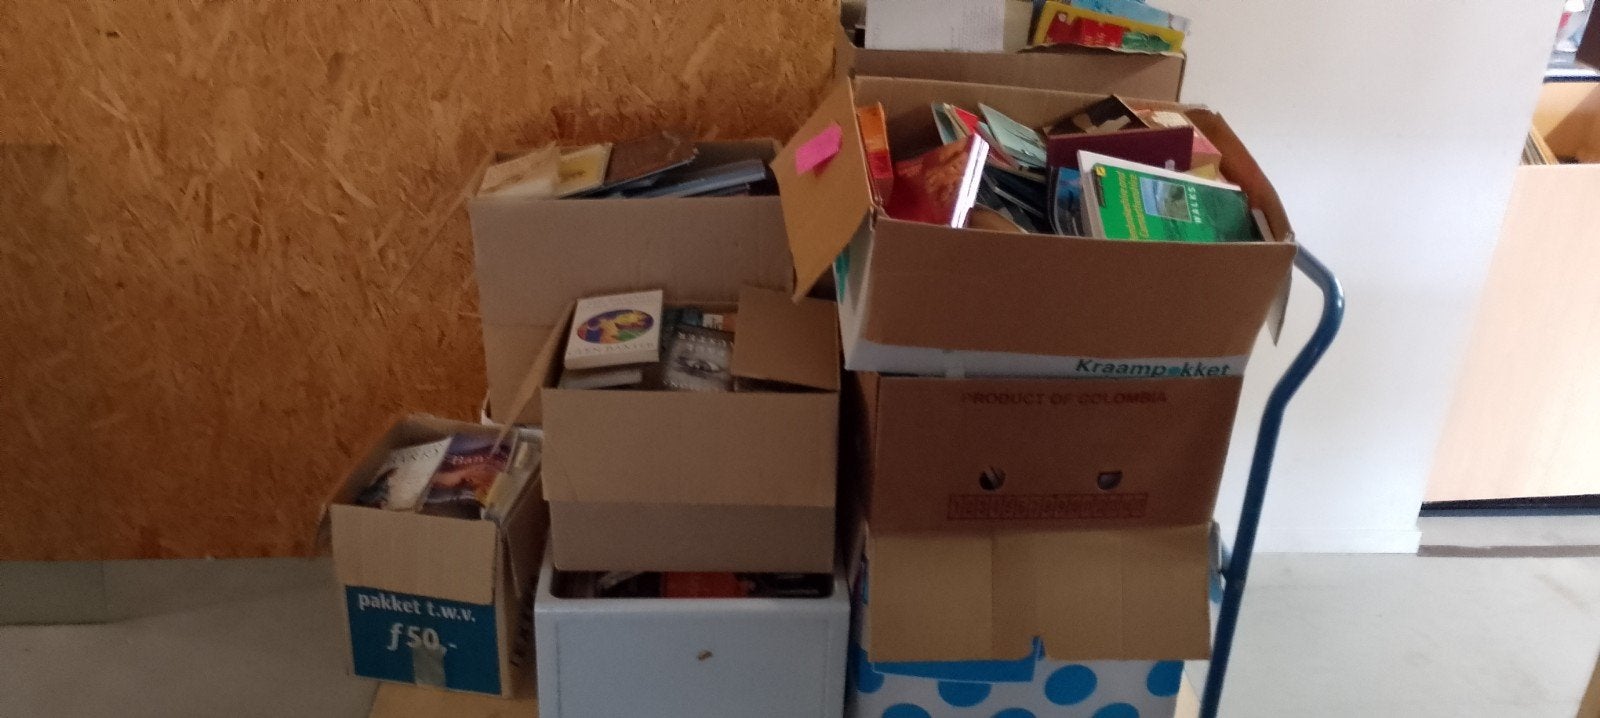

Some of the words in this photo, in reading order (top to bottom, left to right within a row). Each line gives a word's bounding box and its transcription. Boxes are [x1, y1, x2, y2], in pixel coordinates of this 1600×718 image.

[1187, 186, 1202, 224] WALKS
[961, 391, 1045, 404] PRODUCT
[1049, 391, 1074, 404] OF
[1077, 390, 1168, 404] COLOMBIA
[358, 592, 421, 615] pakket
[426, 601, 476, 622] t.w.v.
